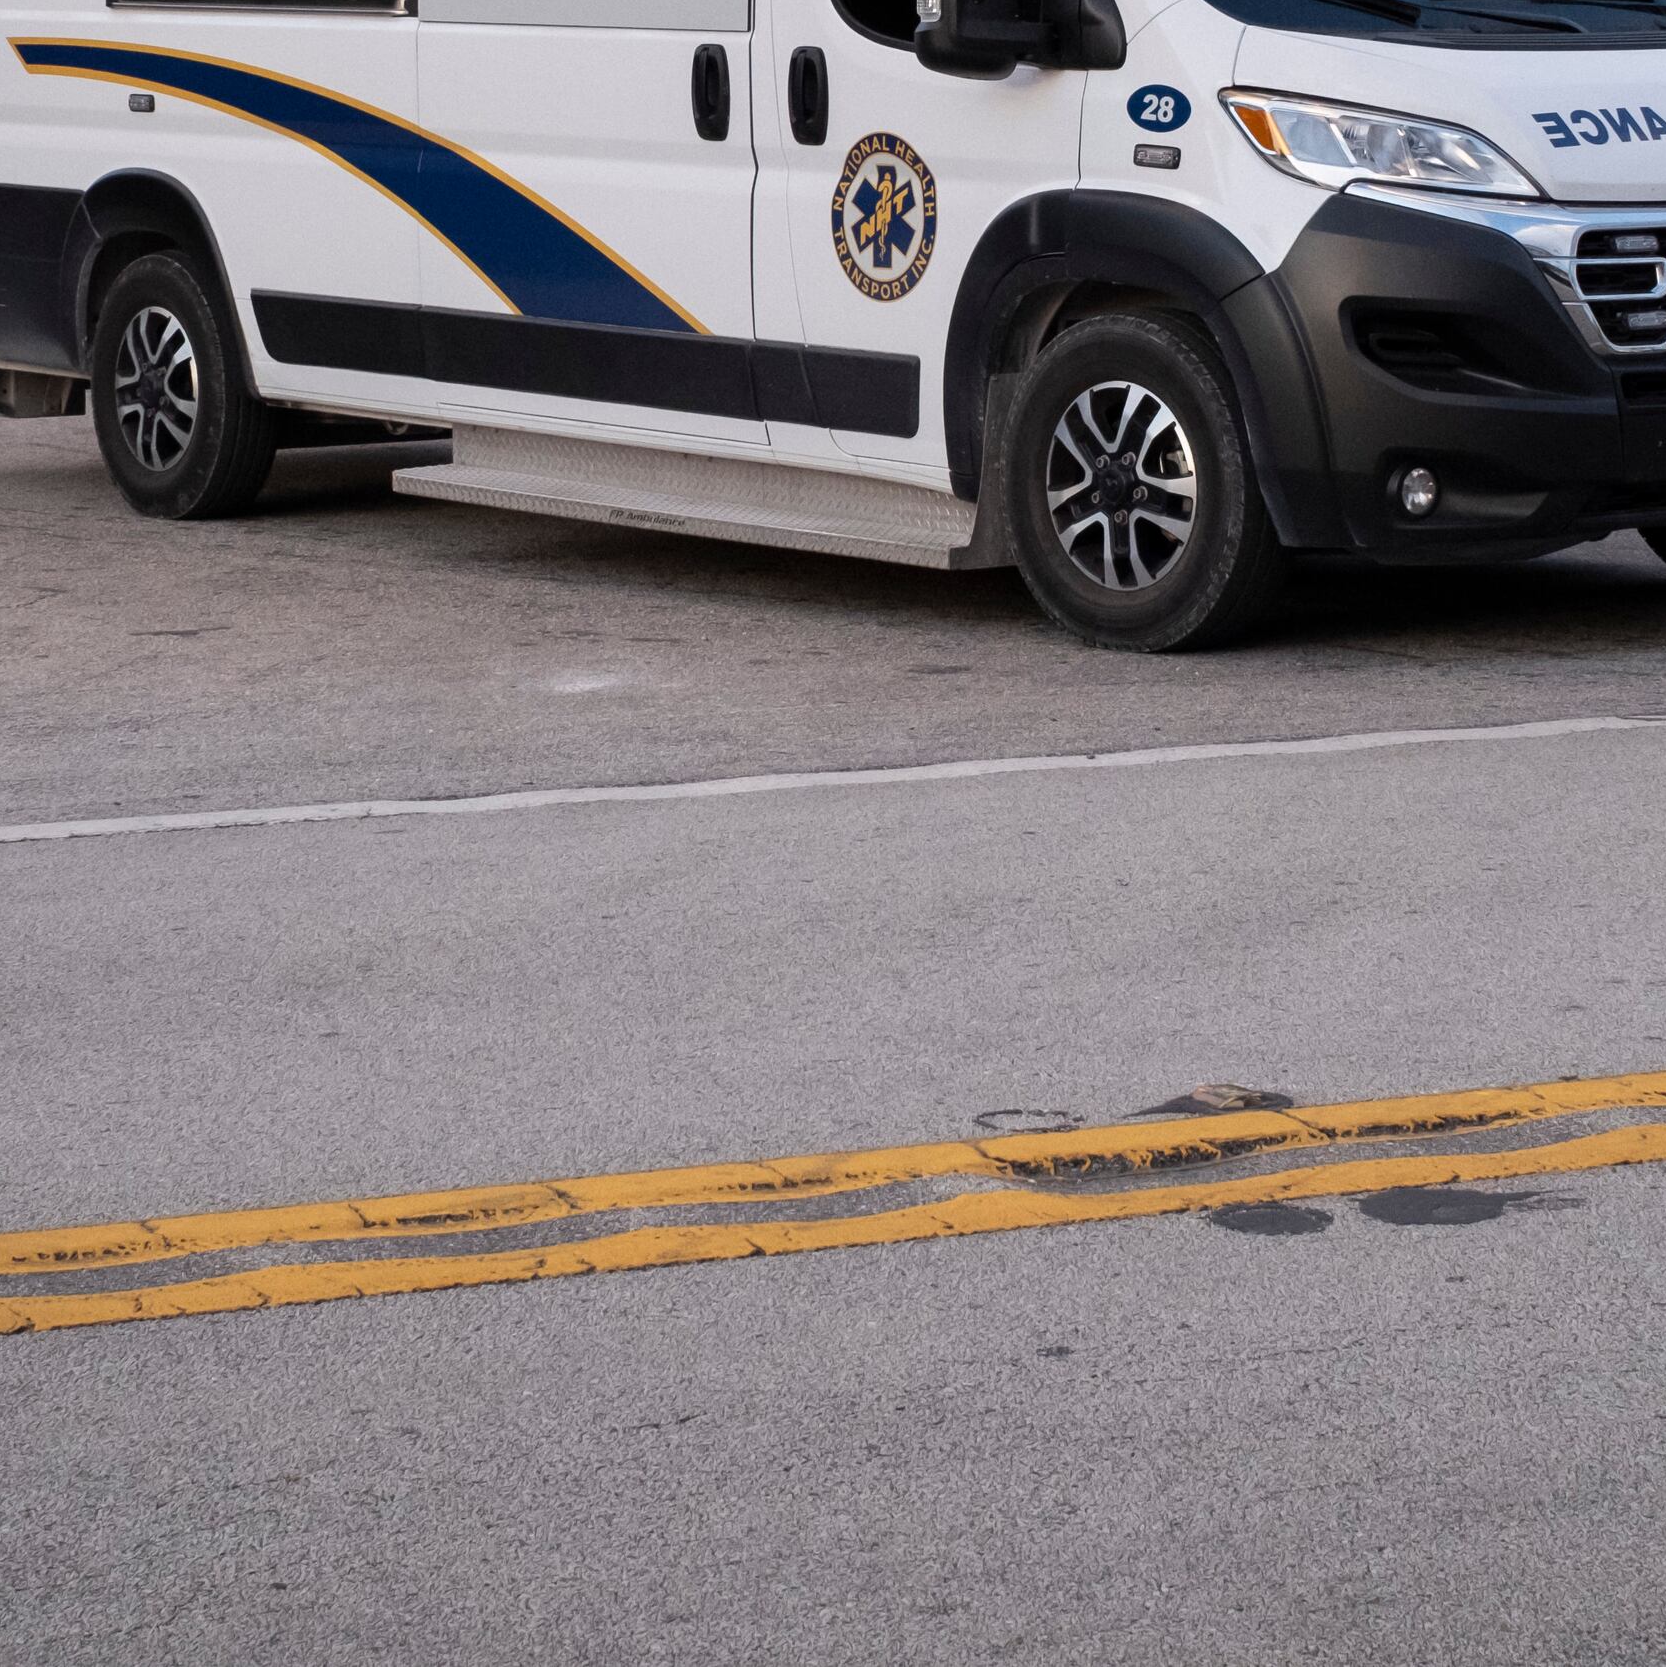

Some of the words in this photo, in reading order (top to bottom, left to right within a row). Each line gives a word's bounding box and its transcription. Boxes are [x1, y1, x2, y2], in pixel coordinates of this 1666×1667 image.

[1140, 93, 1175, 124] 28
[833, 135, 890, 211] NATIONAL
[895, 141, 935, 217] HEALTH
[860, 187, 909, 246] NHT
[833, 226, 910, 300] TRANSPORT
[913, 234, 934, 280] INC.
